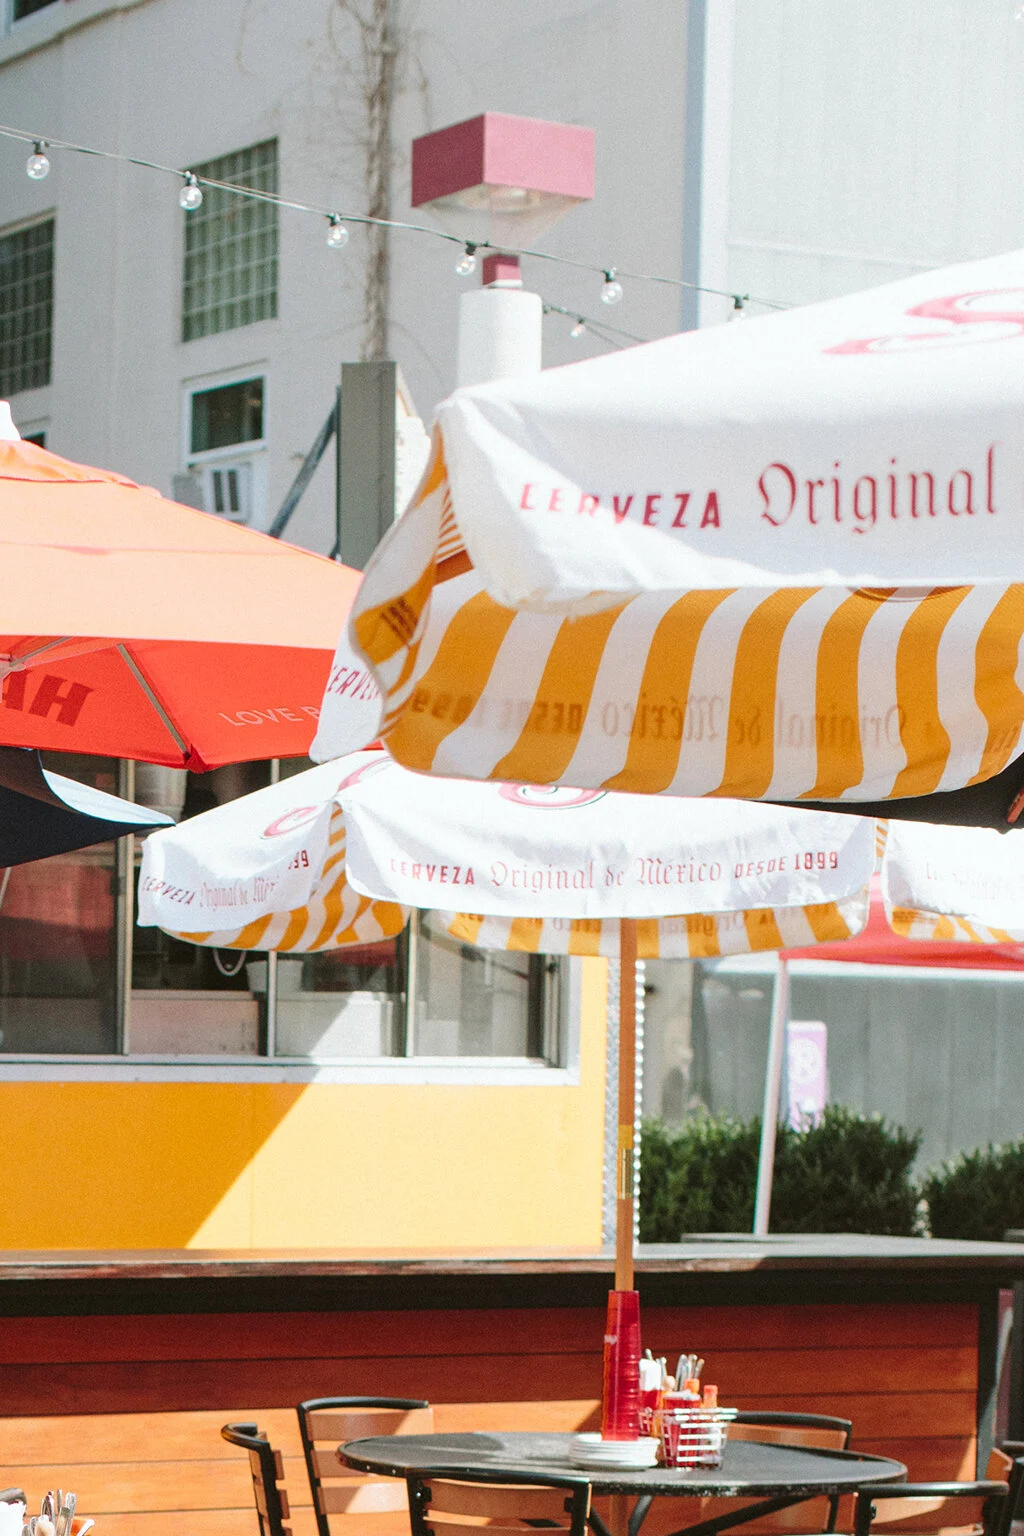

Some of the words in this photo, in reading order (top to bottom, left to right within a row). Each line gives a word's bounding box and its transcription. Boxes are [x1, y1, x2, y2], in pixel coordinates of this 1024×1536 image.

[519, 483, 721, 529] CERVEZA
[757, 439, 1004, 535] Original
[219, 707, 303, 727] LOVE
[390, 858, 475, 886] CERVEZA
[490, 861, 595, 894] Original
[604, 863, 625, 887] de
[734, 857, 785, 879] DESDE
[794, 851, 838, 870] 1899
